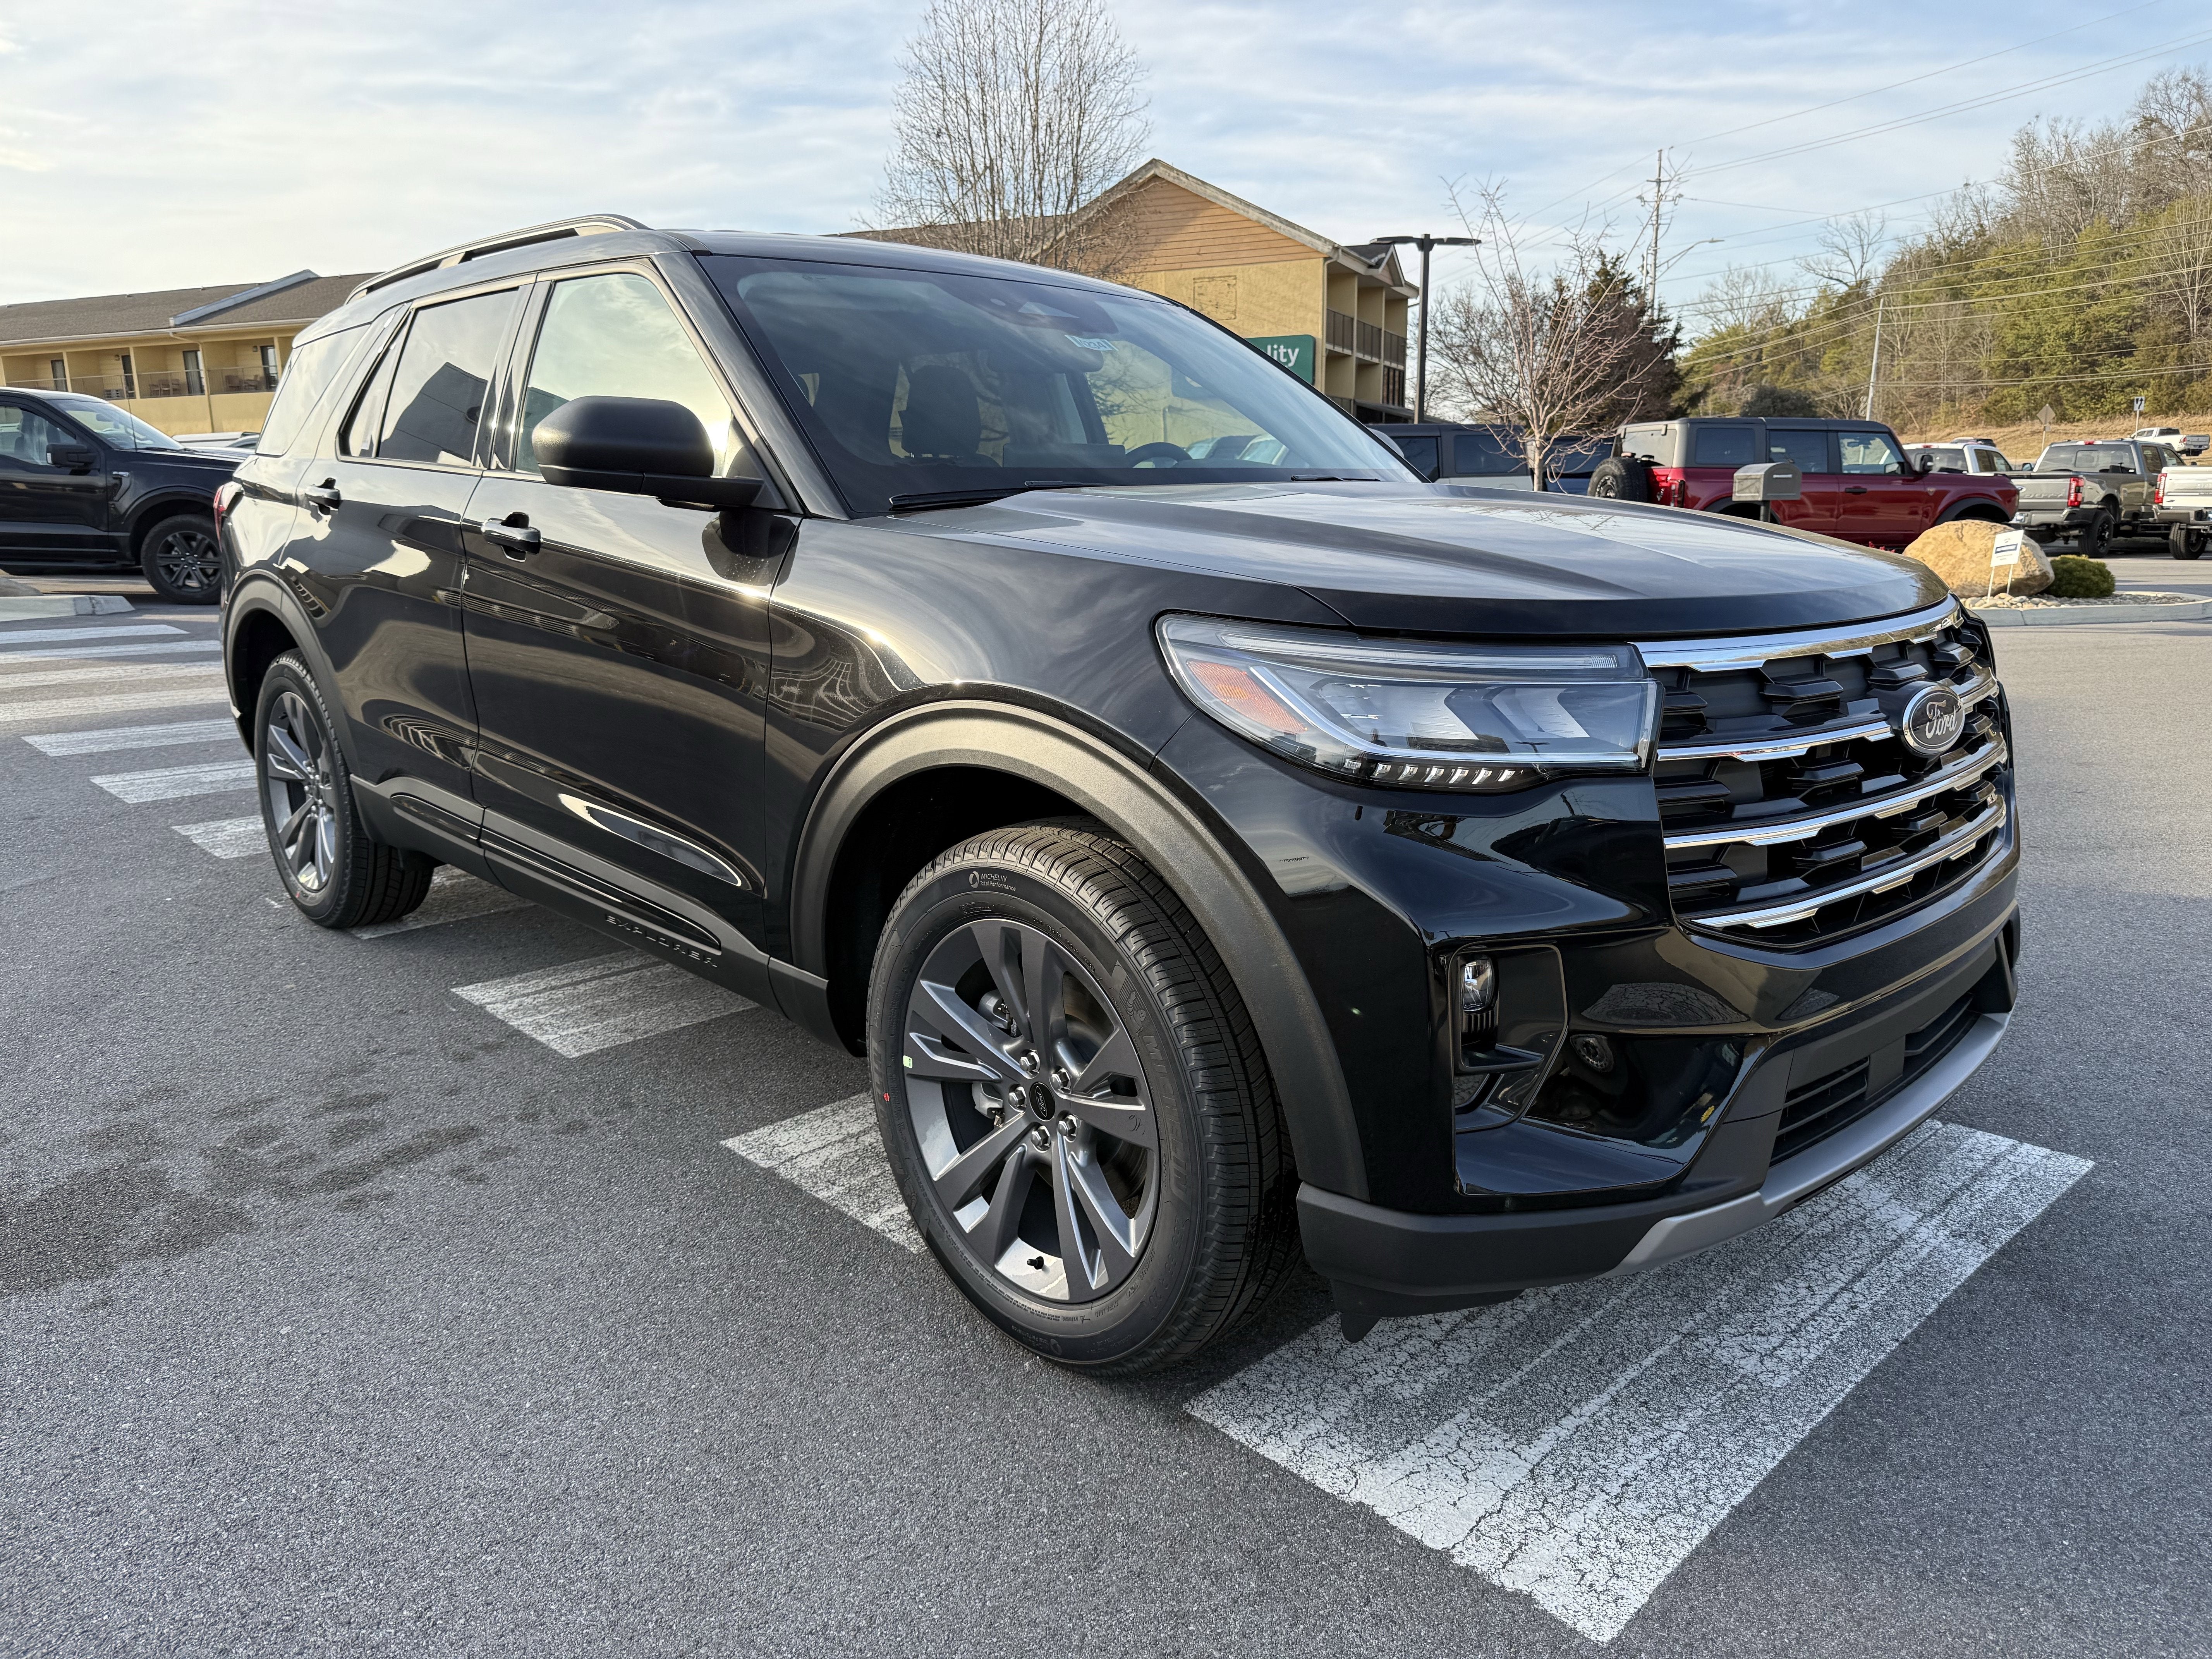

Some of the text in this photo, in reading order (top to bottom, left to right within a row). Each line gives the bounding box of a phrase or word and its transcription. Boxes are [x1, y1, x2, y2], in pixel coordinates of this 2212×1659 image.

[1262, 344, 1300, 367] lity
[1925, 700, 1958, 739] Ford
[981, 873, 1007, 882] MICHELIN
[989, 881, 1016, 891] Performance
[605, 913, 718, 967] EXPLORER
[1037, 1092, 1046, 1111] Ford
[1142, 1036, 1187, 1193] MICHELIN
